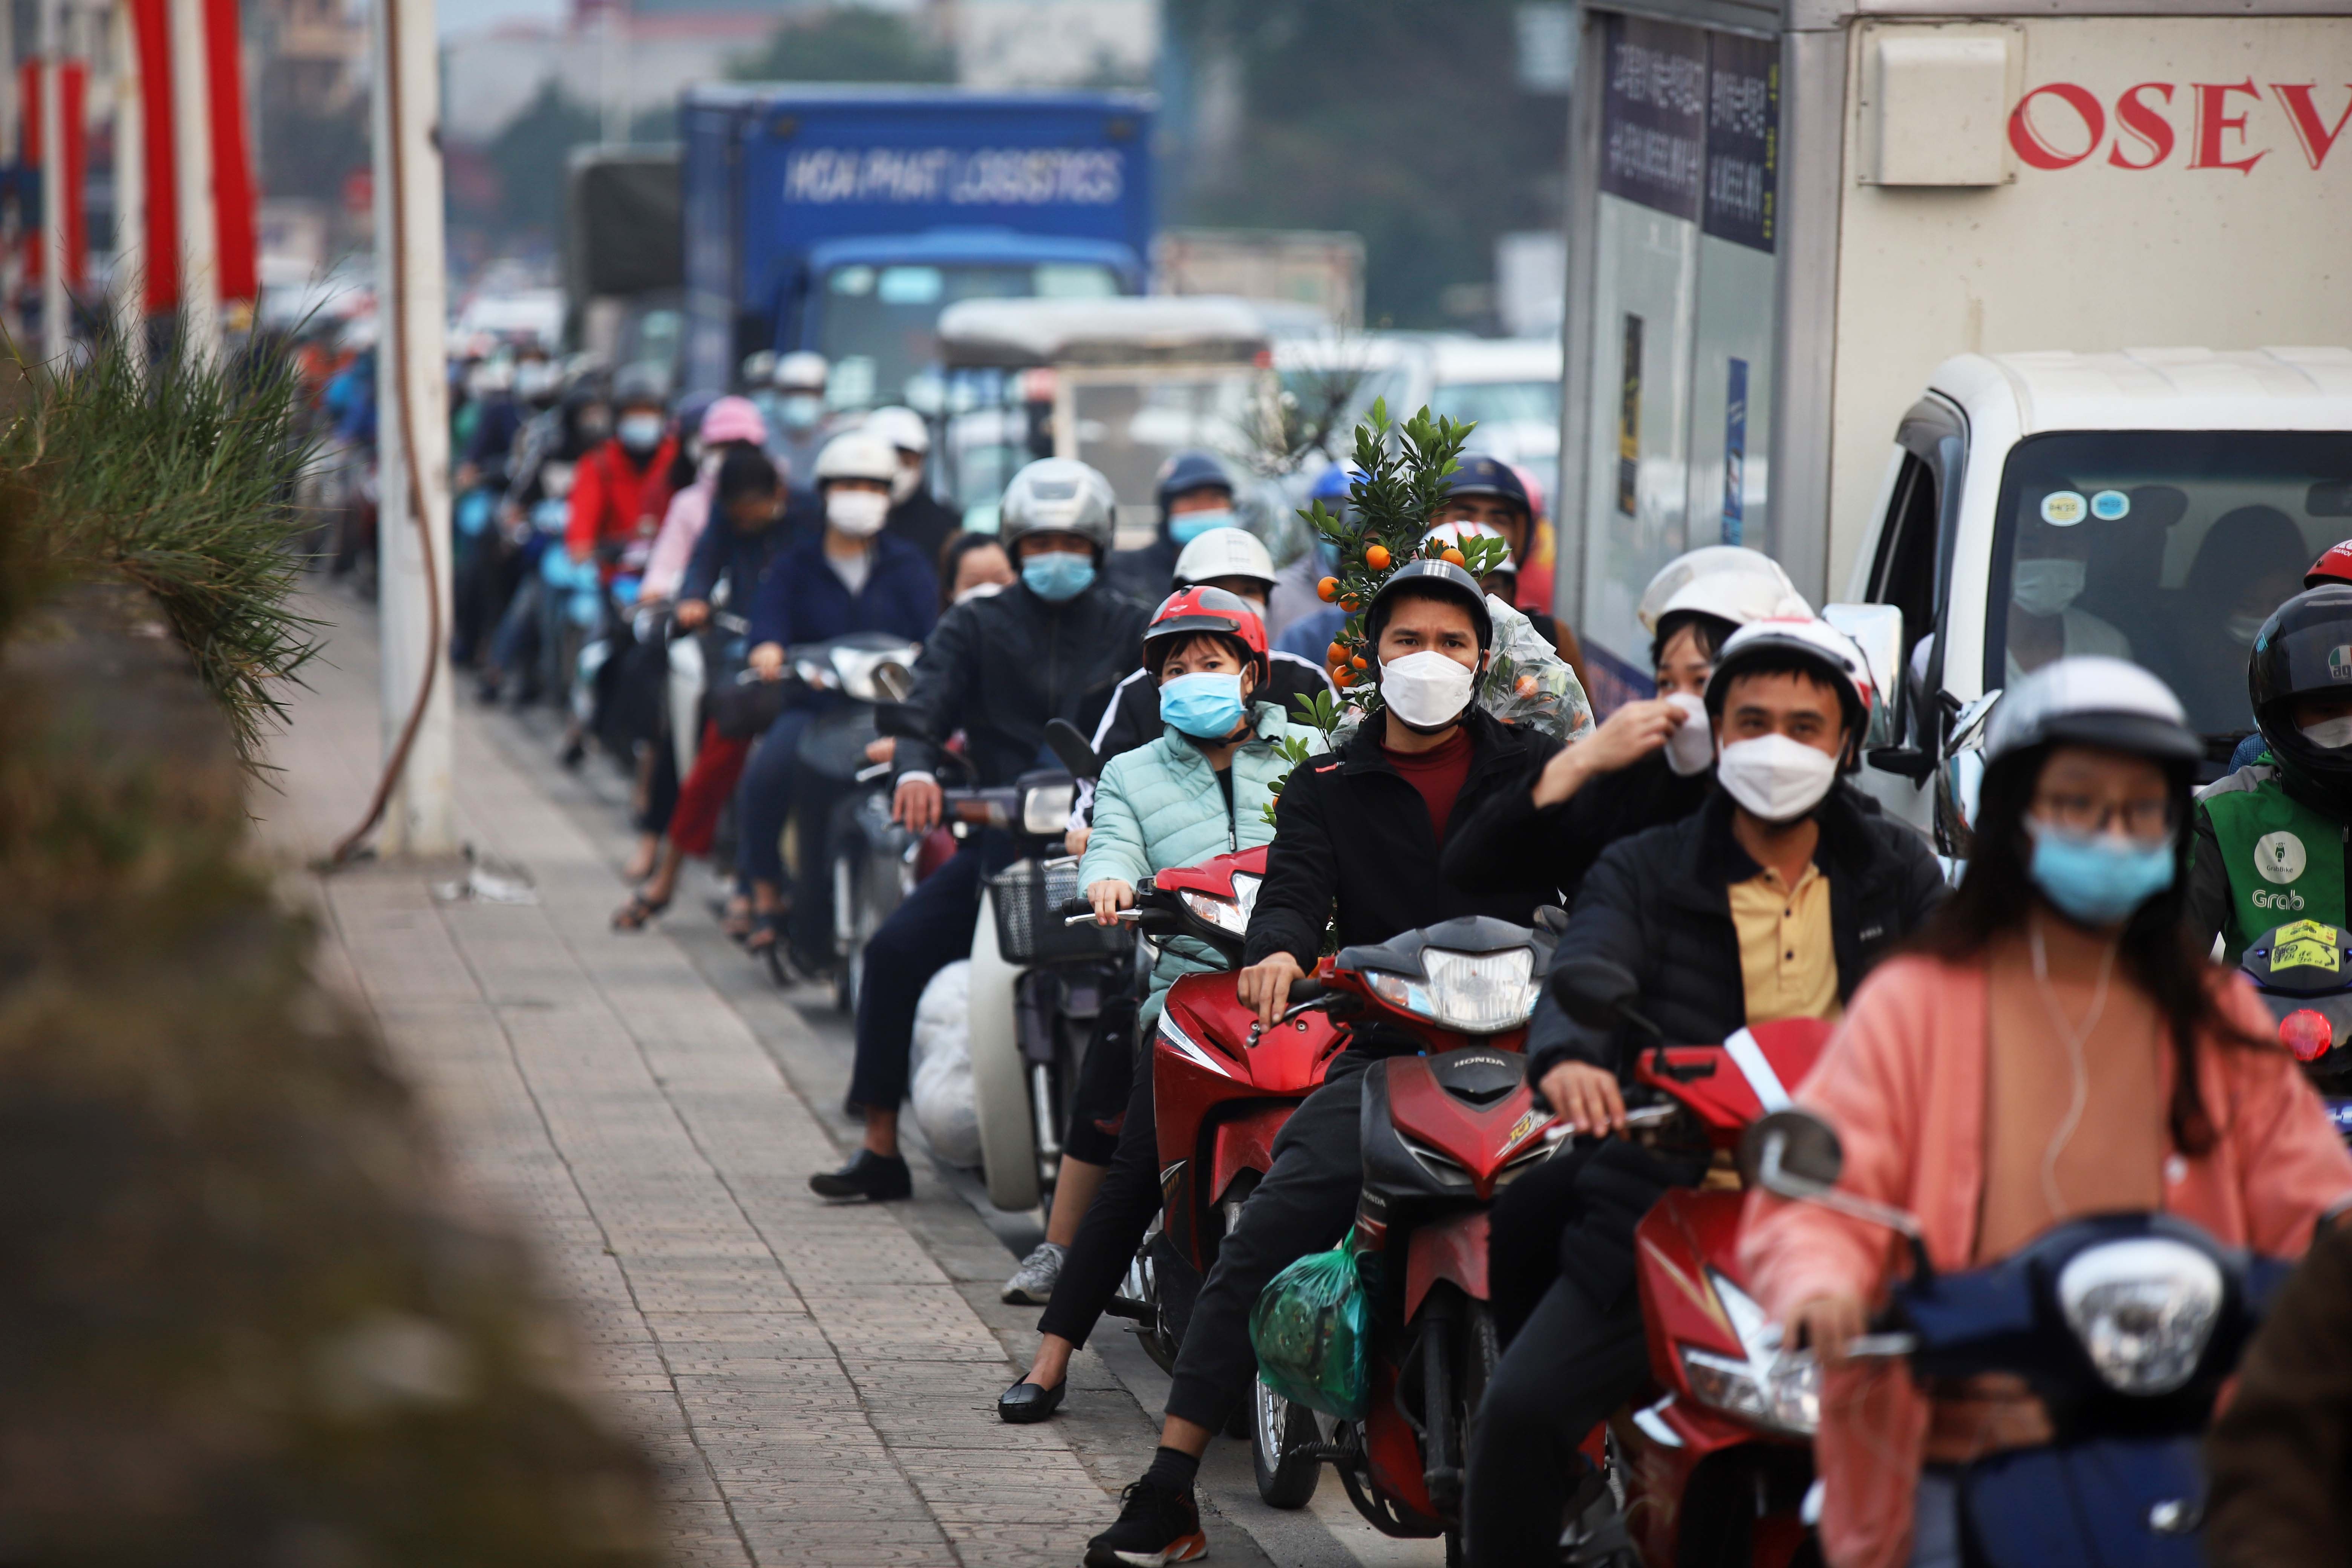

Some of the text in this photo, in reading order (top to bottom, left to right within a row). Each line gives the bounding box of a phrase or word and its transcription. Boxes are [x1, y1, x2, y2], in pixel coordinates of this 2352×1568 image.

[949, 148, 1125, 205] LOGISTICS
[2252, 889, 2305, 911] Grab
[1454, 1057, 1506, 1068] HONDA
